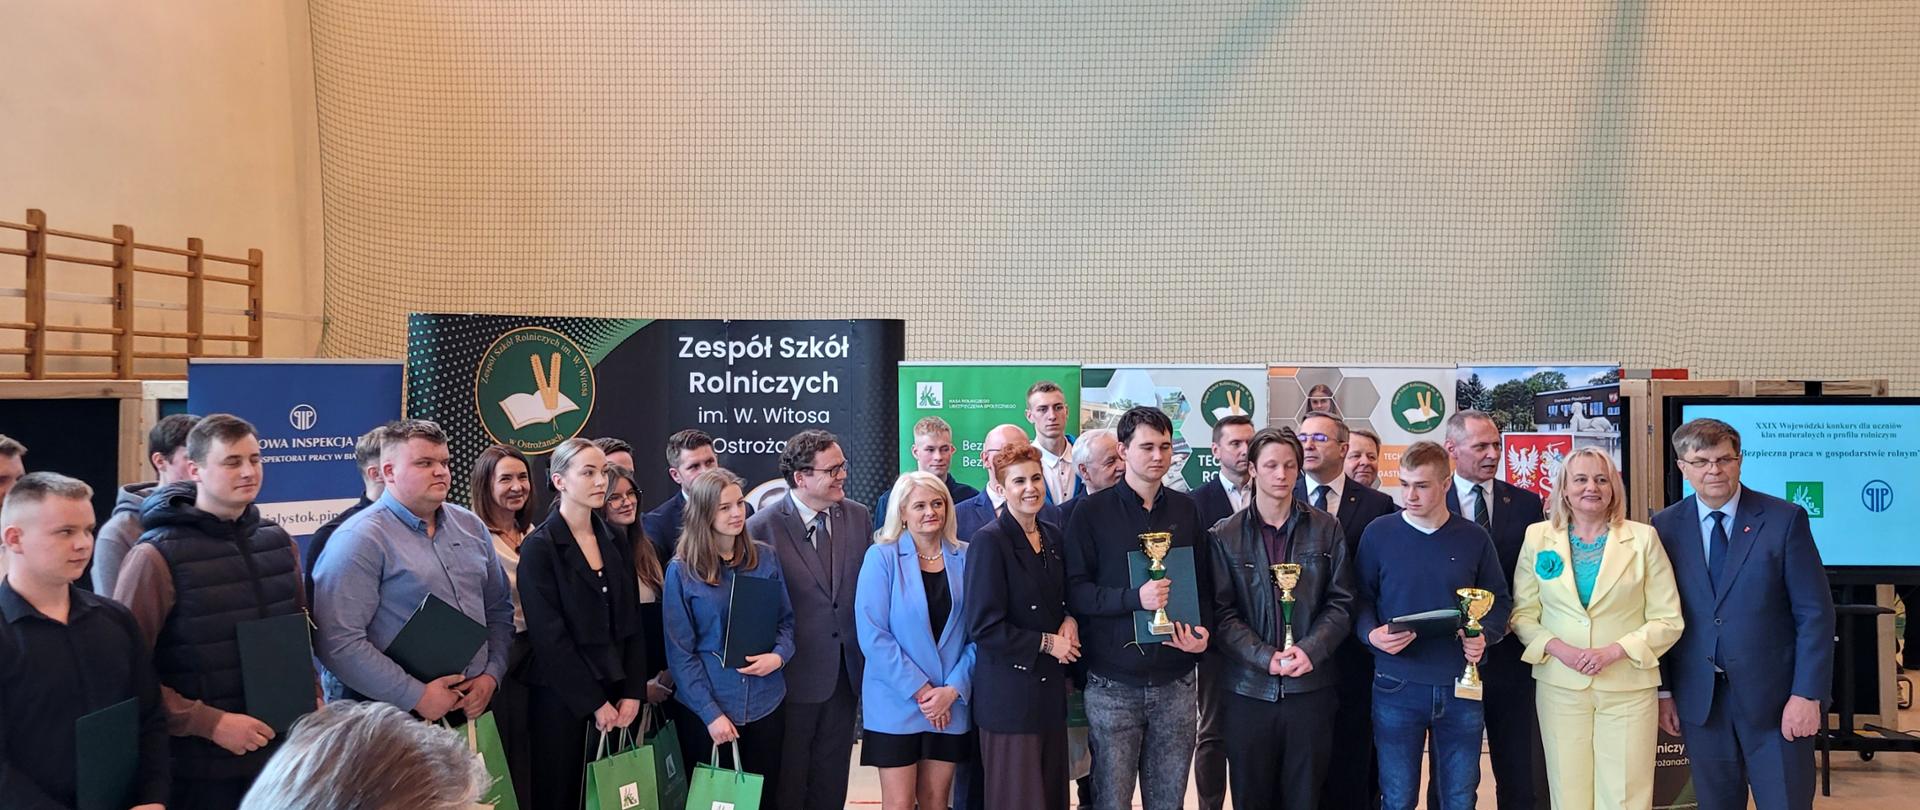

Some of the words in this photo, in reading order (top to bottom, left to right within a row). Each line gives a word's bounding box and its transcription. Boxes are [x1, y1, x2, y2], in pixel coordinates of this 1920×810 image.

[678, 334, 772, 365] Zespół
[779, 334, 849, 358] Szkół
[689, 370, 838, 400] Rolniczych
[698, 406, 728, 424] im.
[733, 407, 757, 424] W.
[763, 407, 830, 424] Witosa
[1826, 421, 1857, 429] konkurs
[1858, 421, 1871, 429] dla
[259, 438, 289, 450] OWA
[291, 436, 354, 449] INSPEKCJA
[713, 438, 788, 454] Ostroża
[963, 440, 983, 451] Bez
[262, 454, 307, 464] SPEKTORAT
[309, 453, 334, 462] PRACY
[344, 453, 358, 461] BIA
[1789, 450, 1814, 459] praca
[1825, 449, 1886, 459] gospodarstwie
[963, 456, 983, 468] Bez
[1197, 454, 1221, 467] TEC
[1657, 743, 1685, 755] niczy
